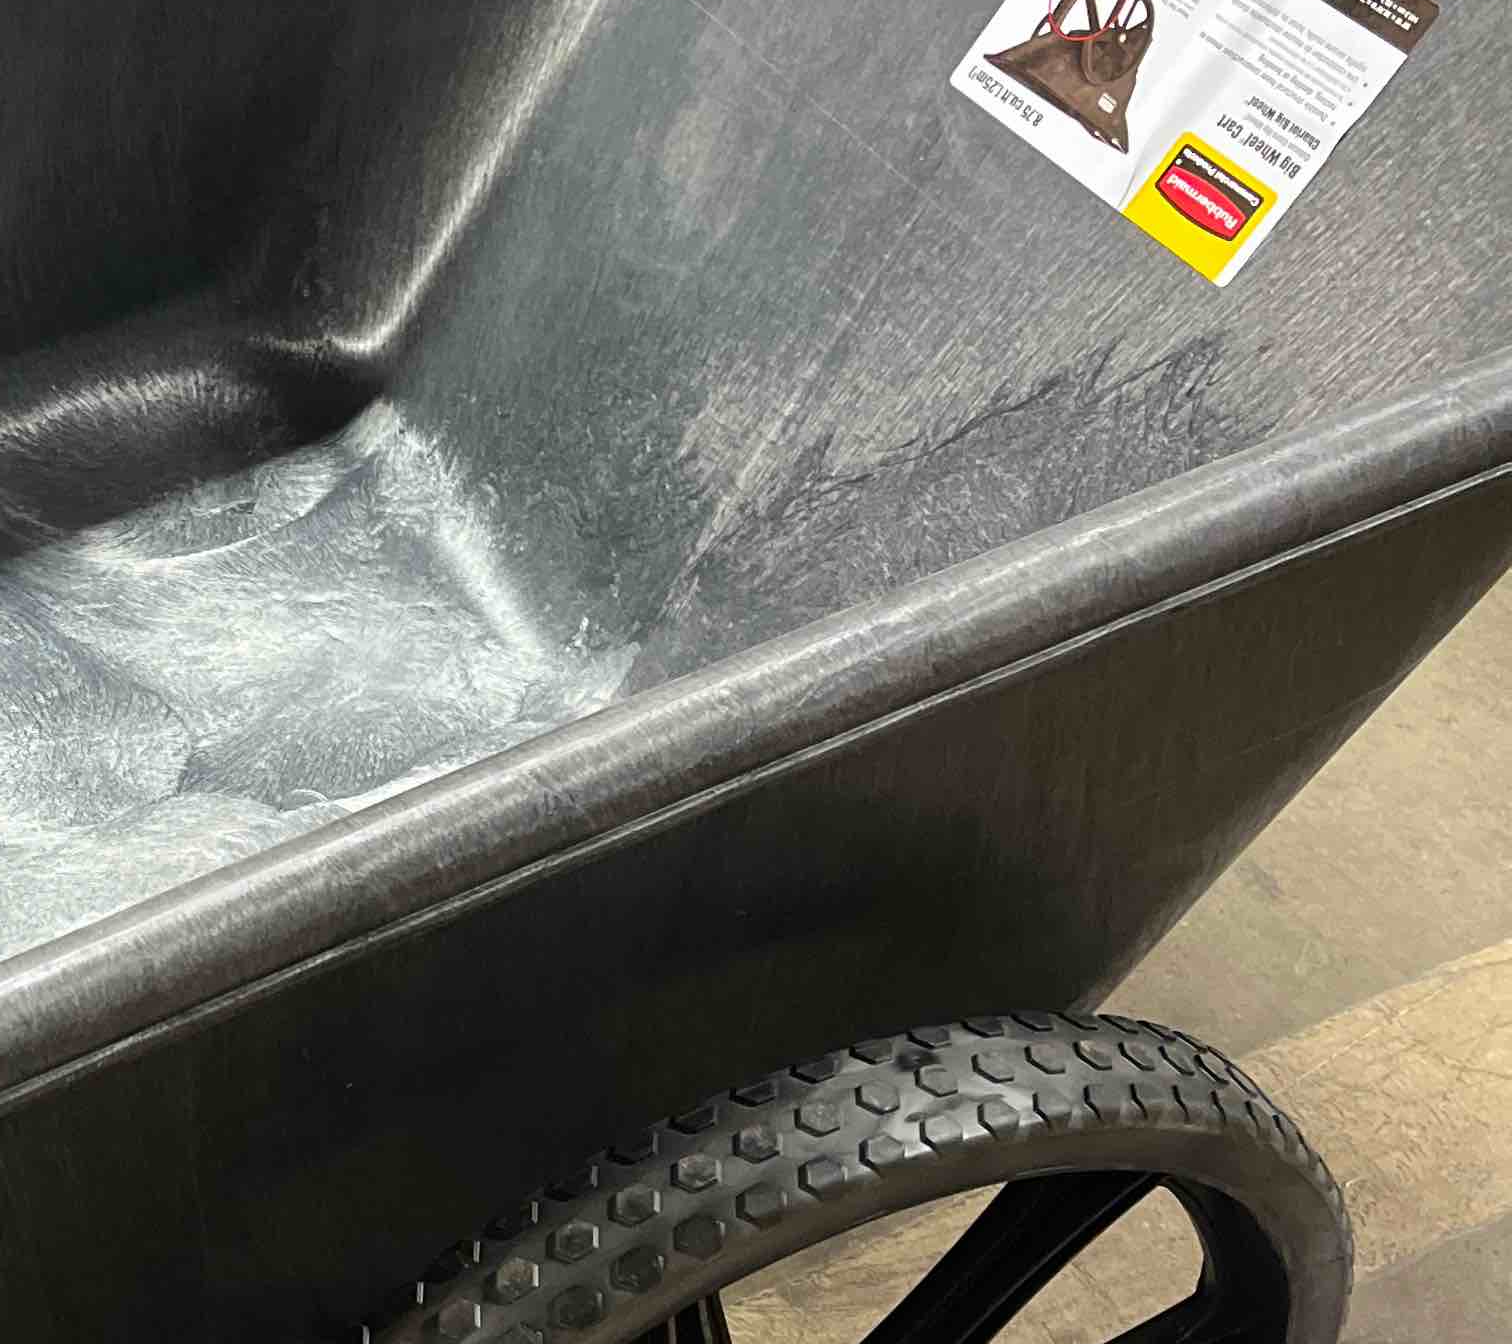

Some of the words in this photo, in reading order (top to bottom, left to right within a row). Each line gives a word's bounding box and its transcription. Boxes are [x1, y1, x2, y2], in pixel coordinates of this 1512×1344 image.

[1215, 113, 1244, 139] Cart
[1276, 155, 1302, 179] Big
[1164, 172, 1238, 230] Rubbermaid
